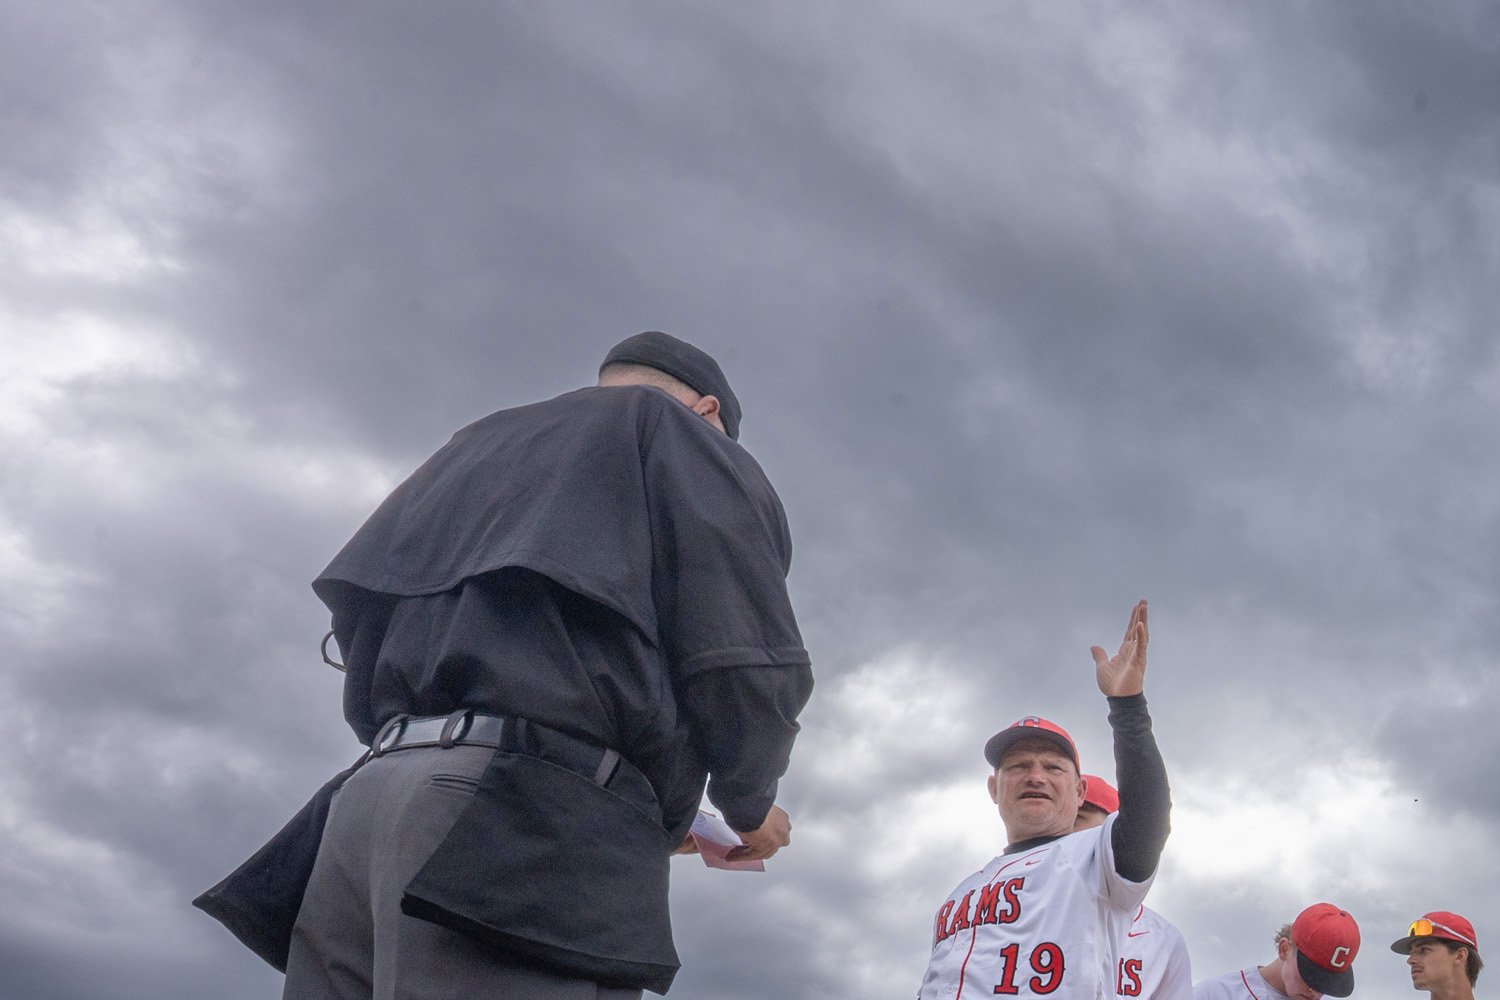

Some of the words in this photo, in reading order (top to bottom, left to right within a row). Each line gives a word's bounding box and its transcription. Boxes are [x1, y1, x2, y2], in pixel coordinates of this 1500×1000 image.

[935, 877, 1026, 946] RAMS
[993, 942, 1066, 995] 19
[1330, 946, 1350, 967] C
